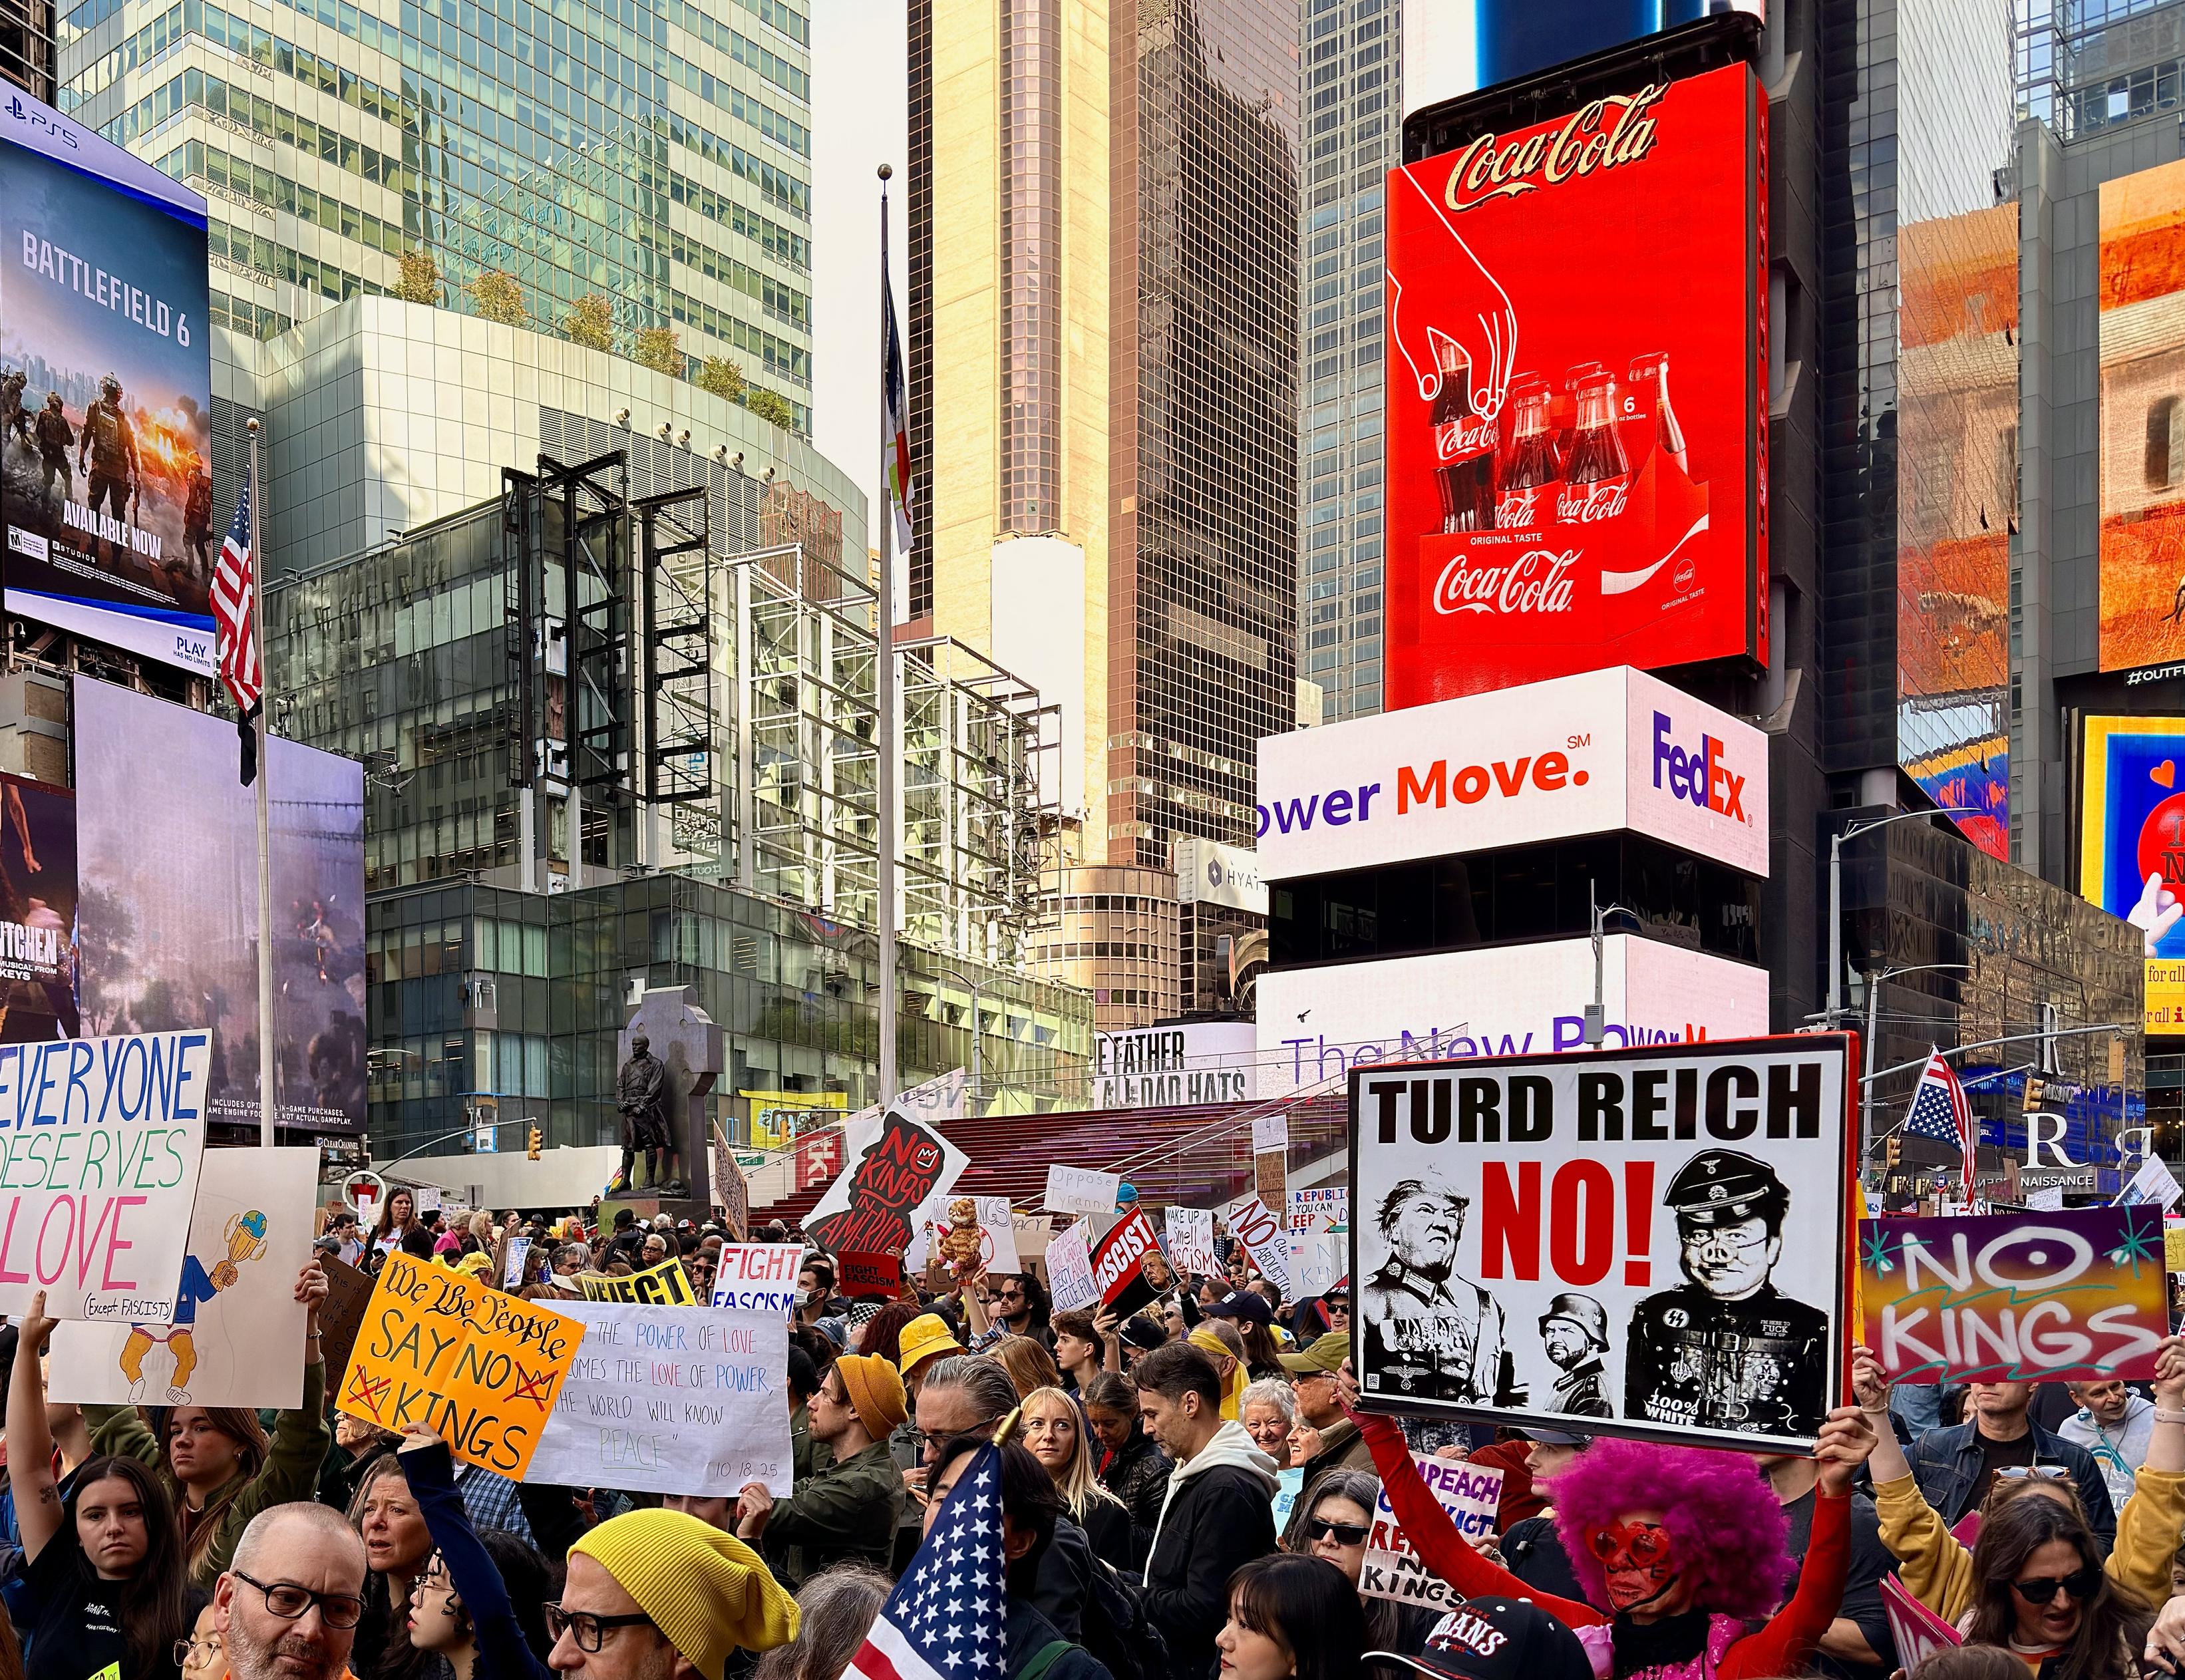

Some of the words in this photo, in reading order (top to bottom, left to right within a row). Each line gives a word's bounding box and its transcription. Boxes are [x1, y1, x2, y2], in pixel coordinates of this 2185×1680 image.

[31, 110, 79, 149] PS5
[1445, 82, 1669, 212] Coca-Cola
[23, 229, 171, 337] BATTLEFIELD
[176, 312, 190, 347] 6
[1623, 397, 1635, 413] 6
[63, 500, 128, 548] AVAILABLE
[132, 526, 162, 560] NOW
[1470, 535, 1512, 546] ORIGINAL
[1514, 532, 1543, 544] TASTE
[61, 545, 96, 564] STUDIOS
[1433, 548, 1584, 616] Coca-Cola
[1661, 595, 1689, 611] ORIGINAL
[1689, 587, 1705, 599] TASTE
[173, 649, 184, 658] HAS
[194, 655, 211, 667] LIMITS
[176, 636, 207, 659] PLAY
[1652, 710, 1746, 822] FedEx
[1396, 750, 1590, 815] Move.
[0, 921, 57, 965] ITCHEN
[35, 965, 57, 975] FROM
[2148, 965, 2166, 983] for
[2155, 1007, 2170, 1023] all
[1114, 1031, 1184, 1075] FATHER
[1188, 1072, 1246, 1104] HATS
[1369, 1075, 1554, 1144] TURD
[1577, 1063, 1822, 1142] REICH
[212, 1098, 245, 1108] INCLUDES
[279, 1104, 306, 1114] IN-GAME
[308, 1107, 345, 1117] PURCHASES.
[224, 1108, 248, 1117] ENGINE
[321, 1116, 352, 1126] GAMEPLAY.
[879, 1126, 939, 1175] NO
[2021, 1112, 2090, 1170] R
[856, 1152, 931, 1206] KINGS
[1053, 1168, 1112, 1188] Oppose
[855, 1194, 876, 1212] IN
[1050, 1186, 1112, 1214] Tyranny
[1296, 1204, 1313, 1214] YOU
[1314, 1202, 1333, 1212] CAN
[1166, 1209, 1185, 1224] WAKE
[1188, 1210, 1200, 1224] UP
[1229, 1198, 1277, 1248] NO
[1481, 1158, 1655, 1287] NO!
[0, 1195, 148, 1291] LOVE
[1174, 1225, 1197, 1246] Smell
[719, 1248, 802, 1281] FIGHT
[1096, 1213, 1153, 1295] FASCIST
[1902, 1226, 2093, 1293] NO
[844, 1265, 879, 1276] FIGHT
[845, 1273, 896, 1289] FASCISM
[383, 1260, 429, 1307] We
[424, 1275, 476, 1322] The
[464, 1294, 566, 1363] People
[597, 1320, 623, 1345] THE
[635, 1323, 689, 1351] POWER
[698, 1325, 719, 1351] OF
[723, 1328, 757, 1354] LOVE
[1763, 1324, 1789, 1334] FUCK
[1881, 1301, 2161, 1376] KINGS
[371, 1309, 456, 1377] SAY
[453, 1343, 512, 1390] NO
[616, 1359, 643, 1383] THE
[651, 1360, 684, 1389] LOVE
[690, 1365, 707, 1389] OF
[587, 1395, 632, 1419] WORLD
[647, 1400, 676, 1424] WILL
[685, 1405, 724, 1425] KNOW
[1647, 1405, 1697, 1427] WHITE
[1649, 1393, 1700, 1415] 100%
[392, 1381, 528, 1471] KINGS
[1363, 1565, 1464, 1609] KINGS
